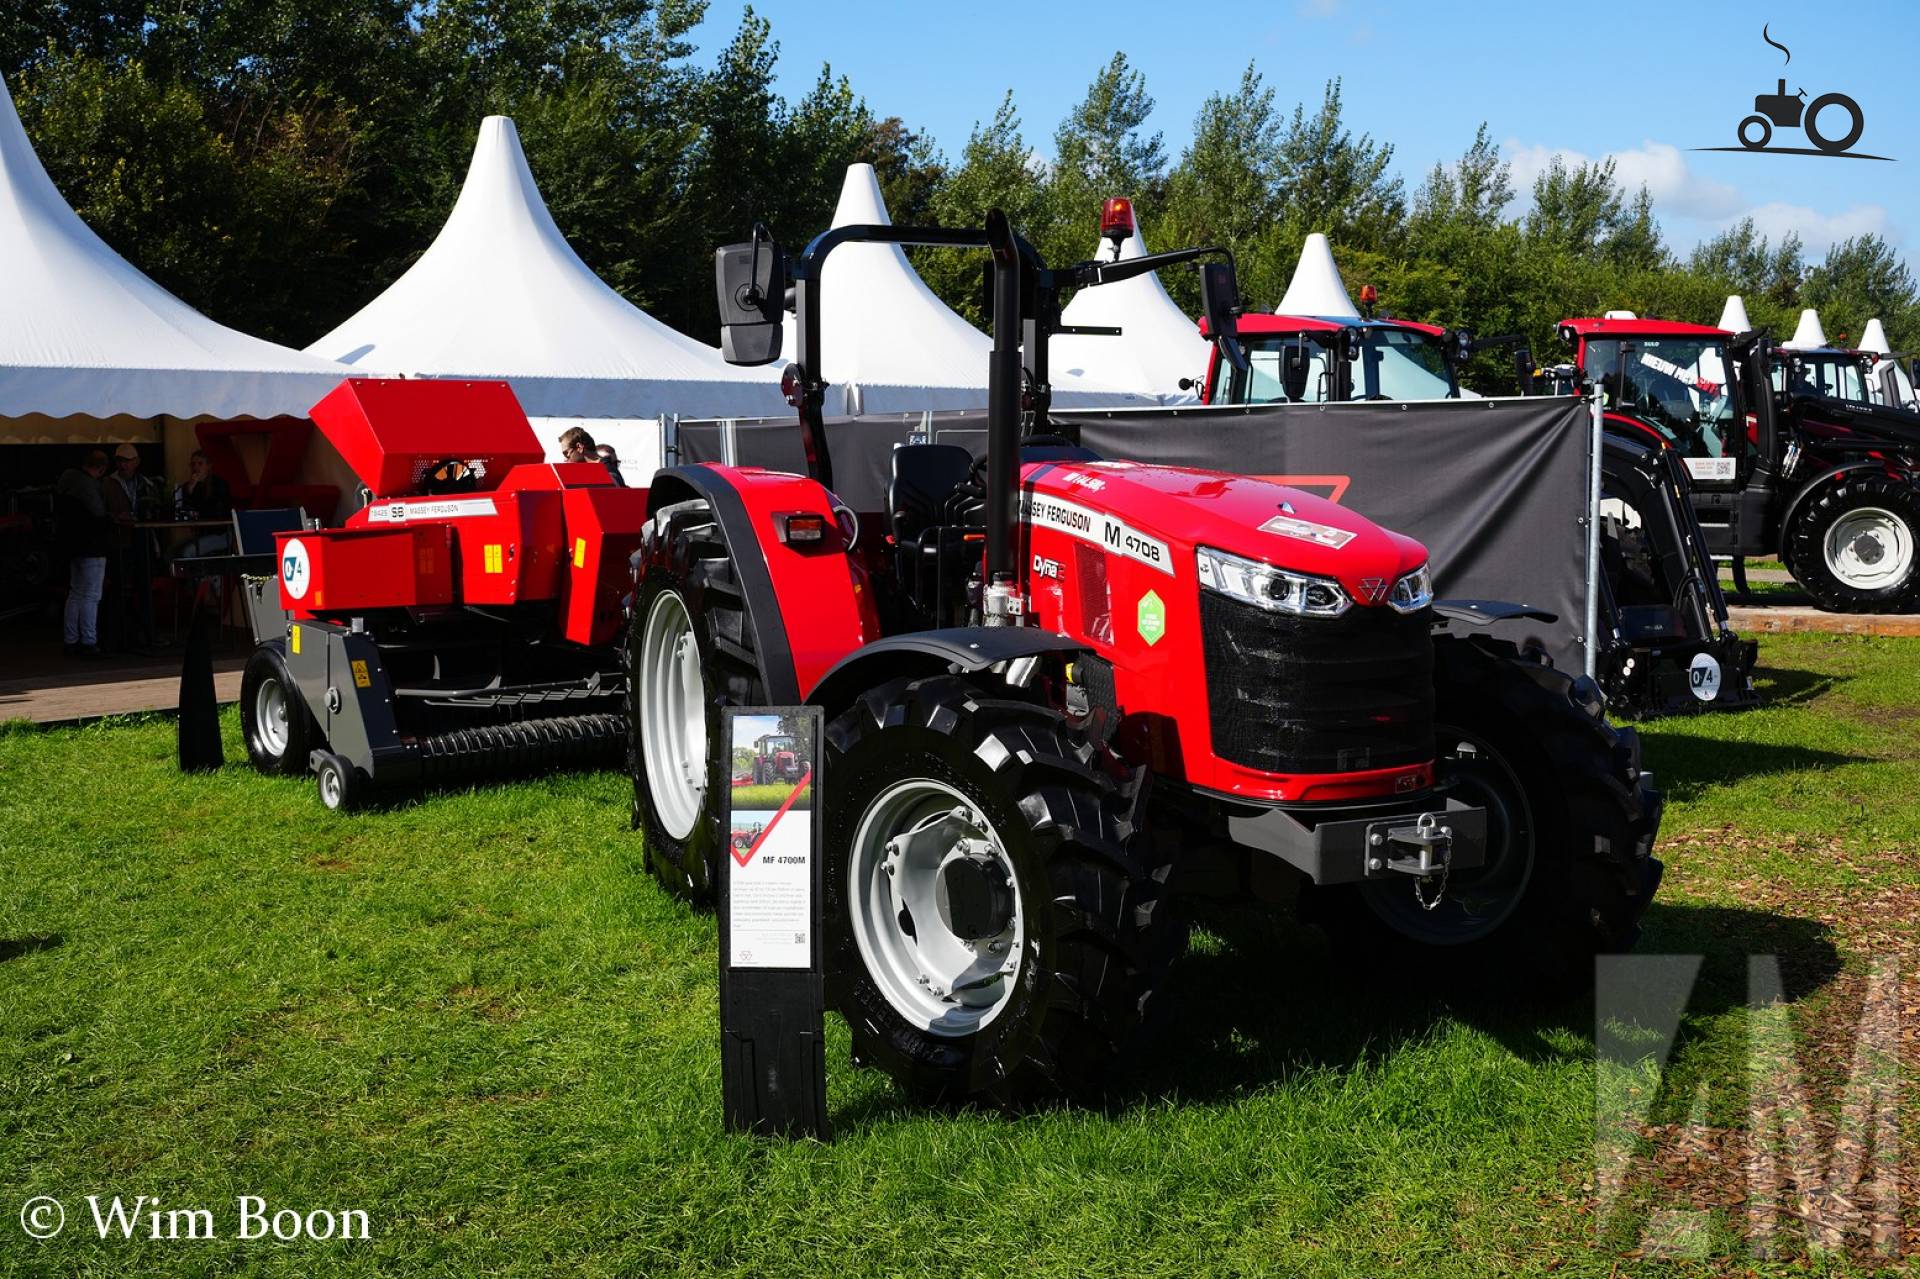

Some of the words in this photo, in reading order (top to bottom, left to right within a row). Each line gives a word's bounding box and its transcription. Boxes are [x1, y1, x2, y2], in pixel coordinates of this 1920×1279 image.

[1046, 504, 1091, 533] FERGUSON
[1104, 521, 1121, 548] M
[1125, 535, 1161, 562] 4708
[762, 856, 775, 864] MF
[777, 856, 806, 864] 4700M
